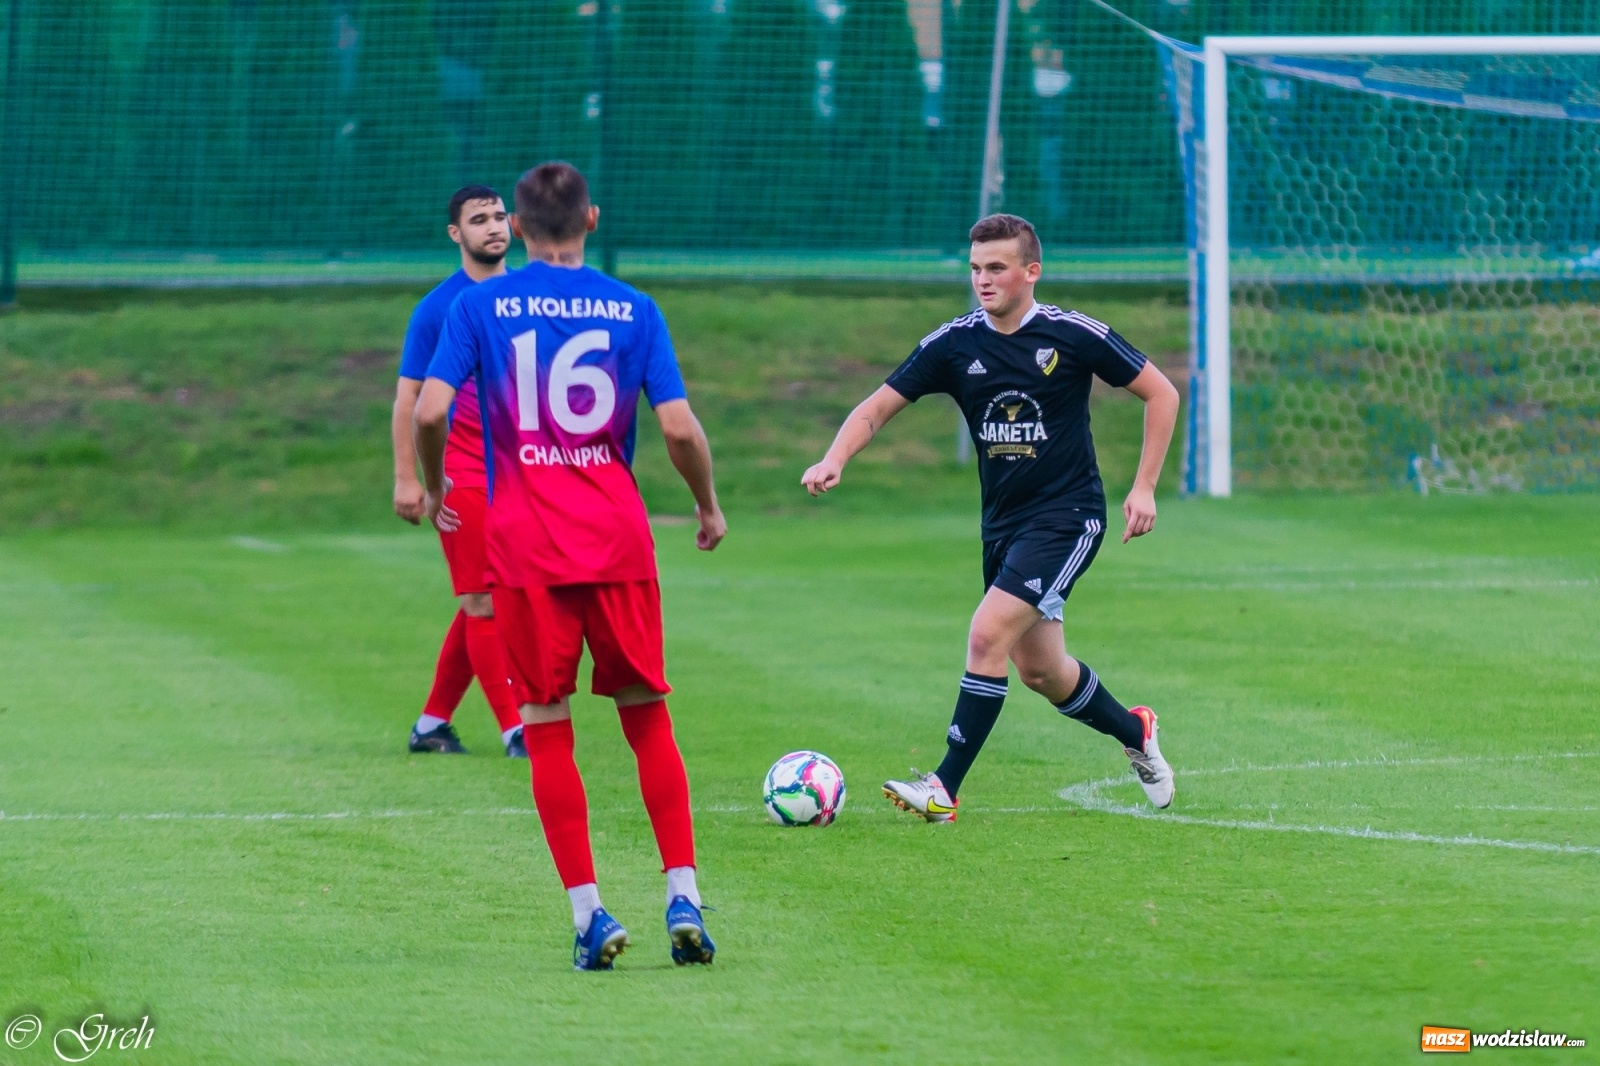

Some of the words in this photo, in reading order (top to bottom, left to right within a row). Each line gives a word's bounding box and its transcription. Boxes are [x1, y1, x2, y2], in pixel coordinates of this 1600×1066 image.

[495, 296, 522, 318] KS
[527, 296, 634, 322] KOLEJARZ
[511, 328, 616, 435] 16
[978, 421, 1049, 443] JANETA
